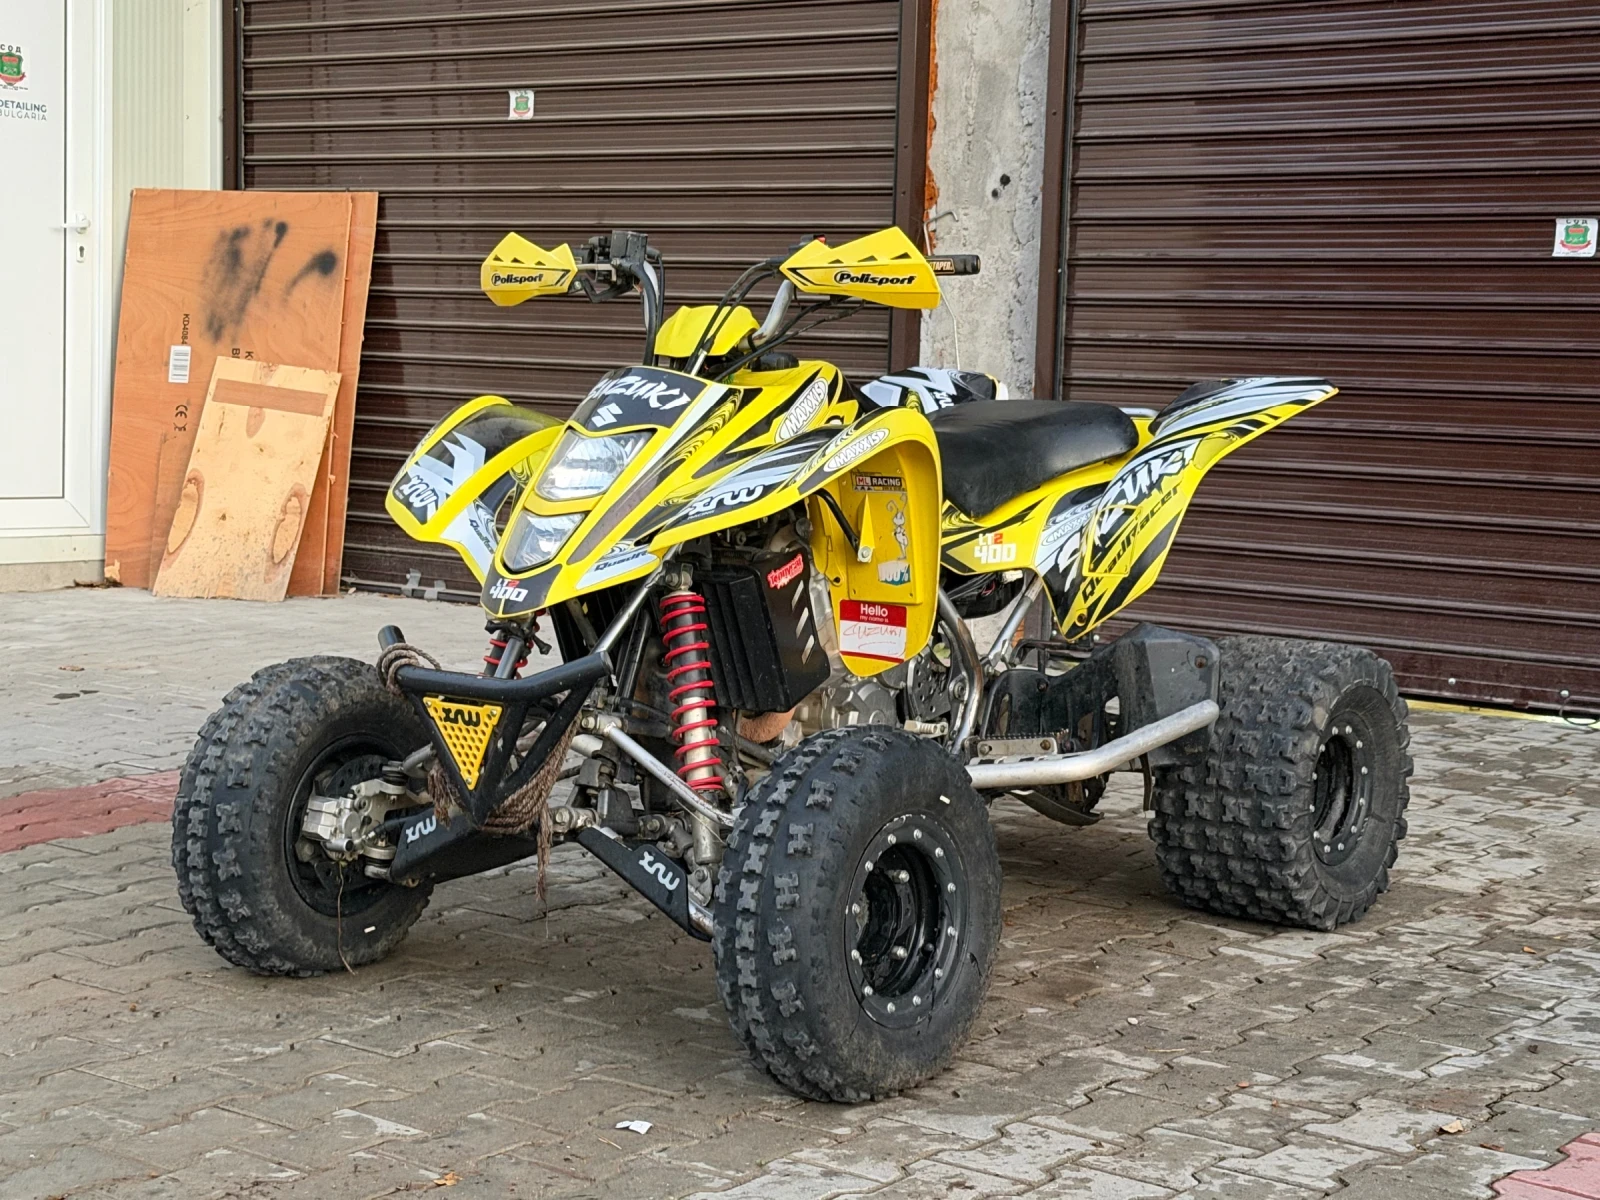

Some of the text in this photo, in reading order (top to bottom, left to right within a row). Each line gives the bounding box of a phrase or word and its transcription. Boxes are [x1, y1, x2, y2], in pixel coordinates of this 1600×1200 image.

[491, 273, 544, 286] Polisport
[834, 270, 917, 286] Polisport
[181, 313, 190, 345] KD4084
[784, 382, 825, 437] MAXXIS
[834, 431, 880, 467] MAXXIS
[857, 477, 901, 487] ML RACING
[974, 543, 1017, 565] 400
[489, 586, 529, 602] 400
[860, 602, 889, 618] Hello
